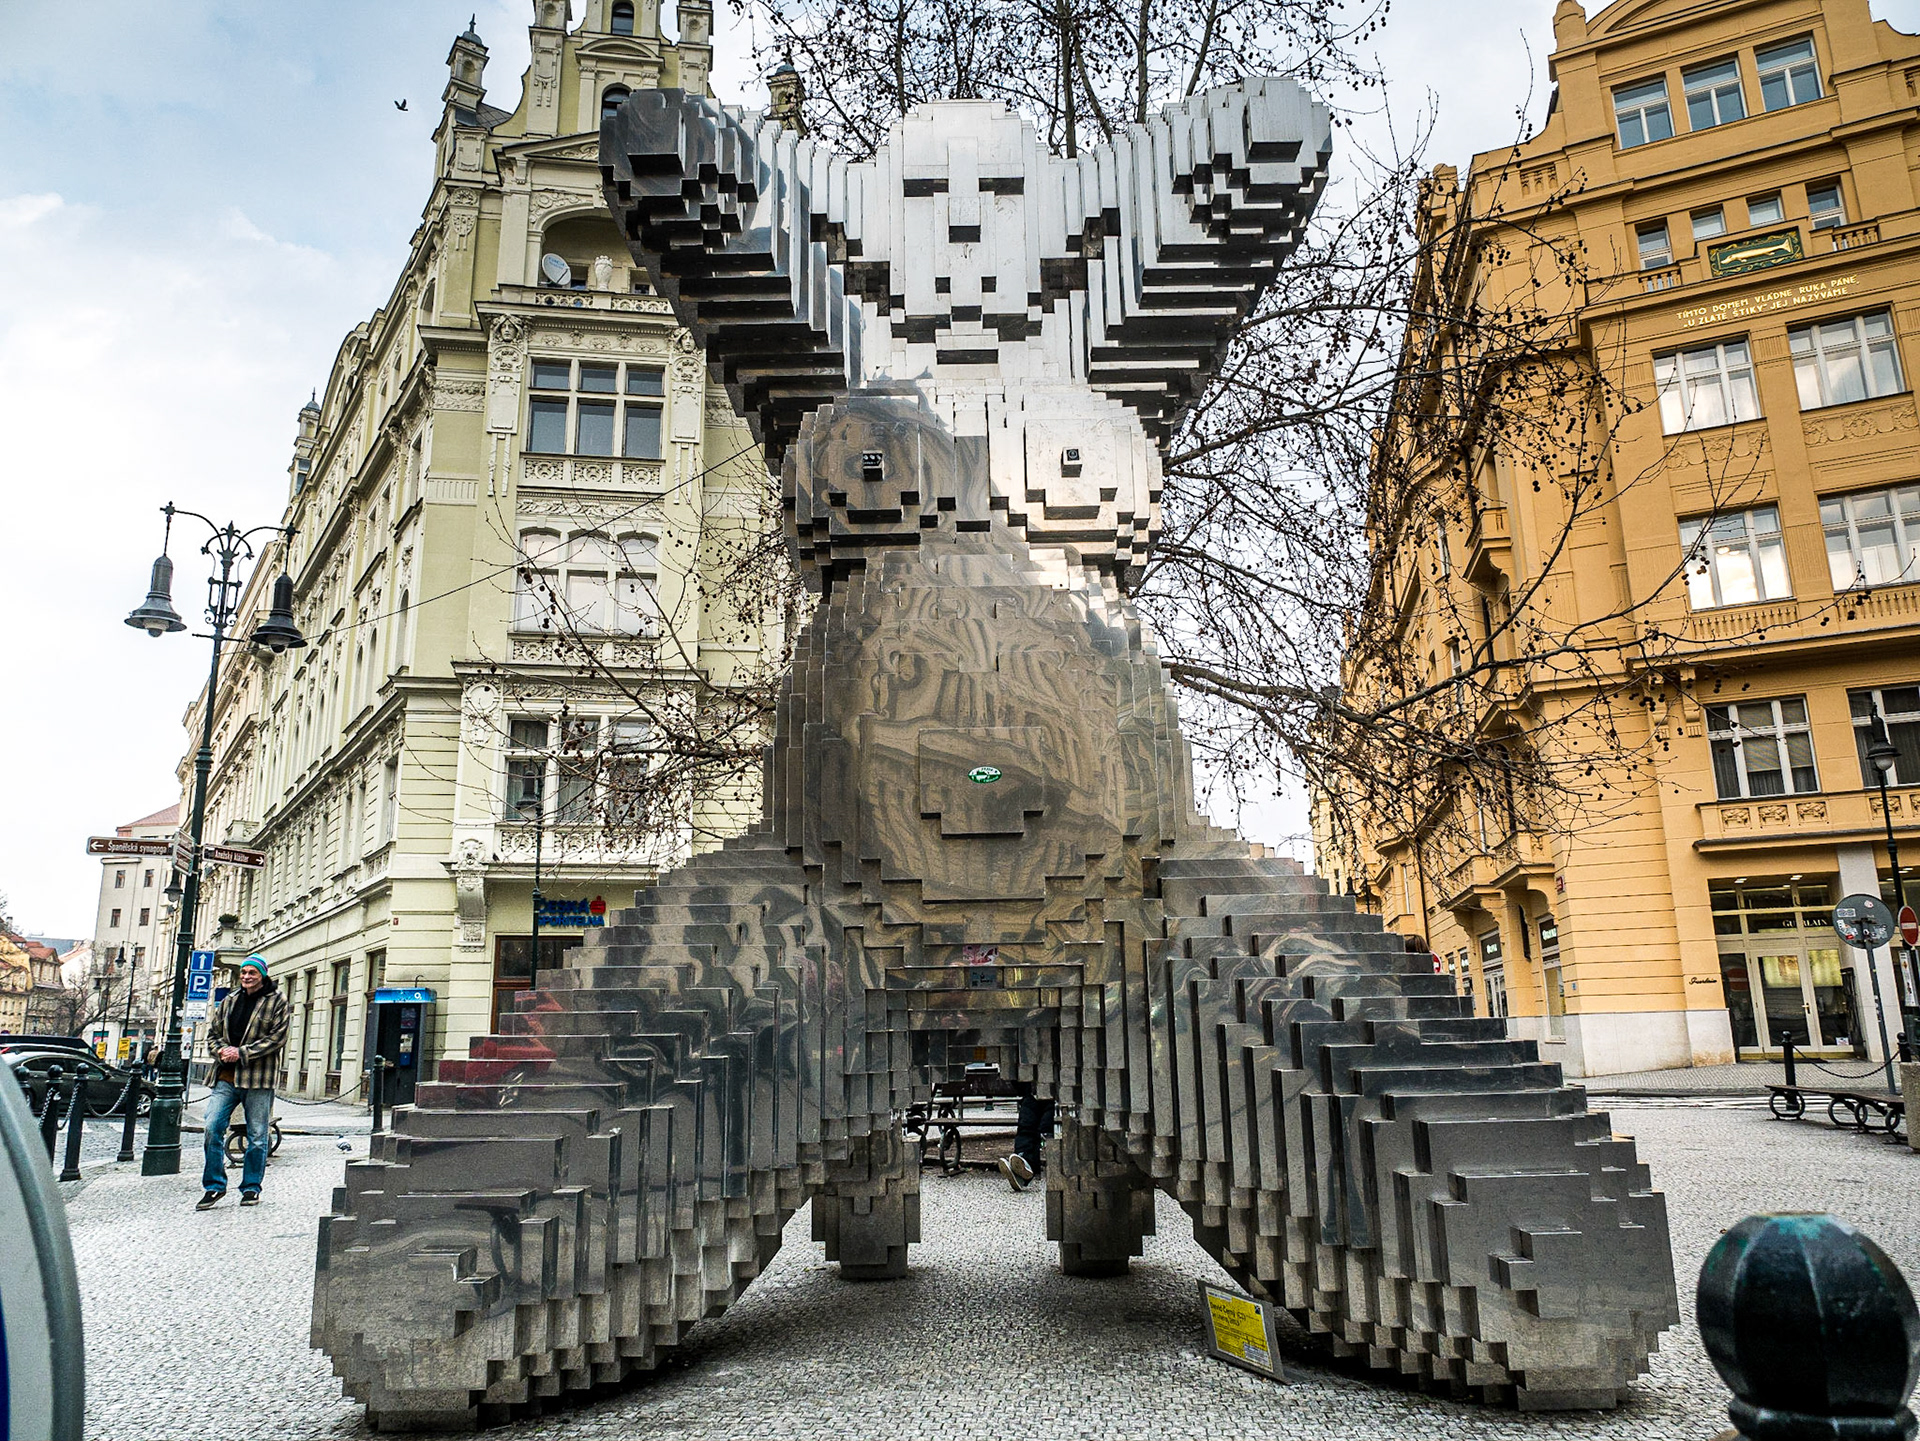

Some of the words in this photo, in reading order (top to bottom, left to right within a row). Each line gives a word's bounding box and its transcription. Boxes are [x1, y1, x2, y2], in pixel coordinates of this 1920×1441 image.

[1676, 307, 1707, 320] TÍMTO
[1713, 299, 1749, 313] DOMEM
[1754, 290, 1793, 304] VLÁDNE
[1799, 282, 1827, 294] RUKA
[1698, 311, 1728, 325] ZLATÉ
[1770, 300, 1788, 311] JEJ
[1794, 287, 1848, 305] NAZÝVÁME
[193, 975, 207, 992] P
